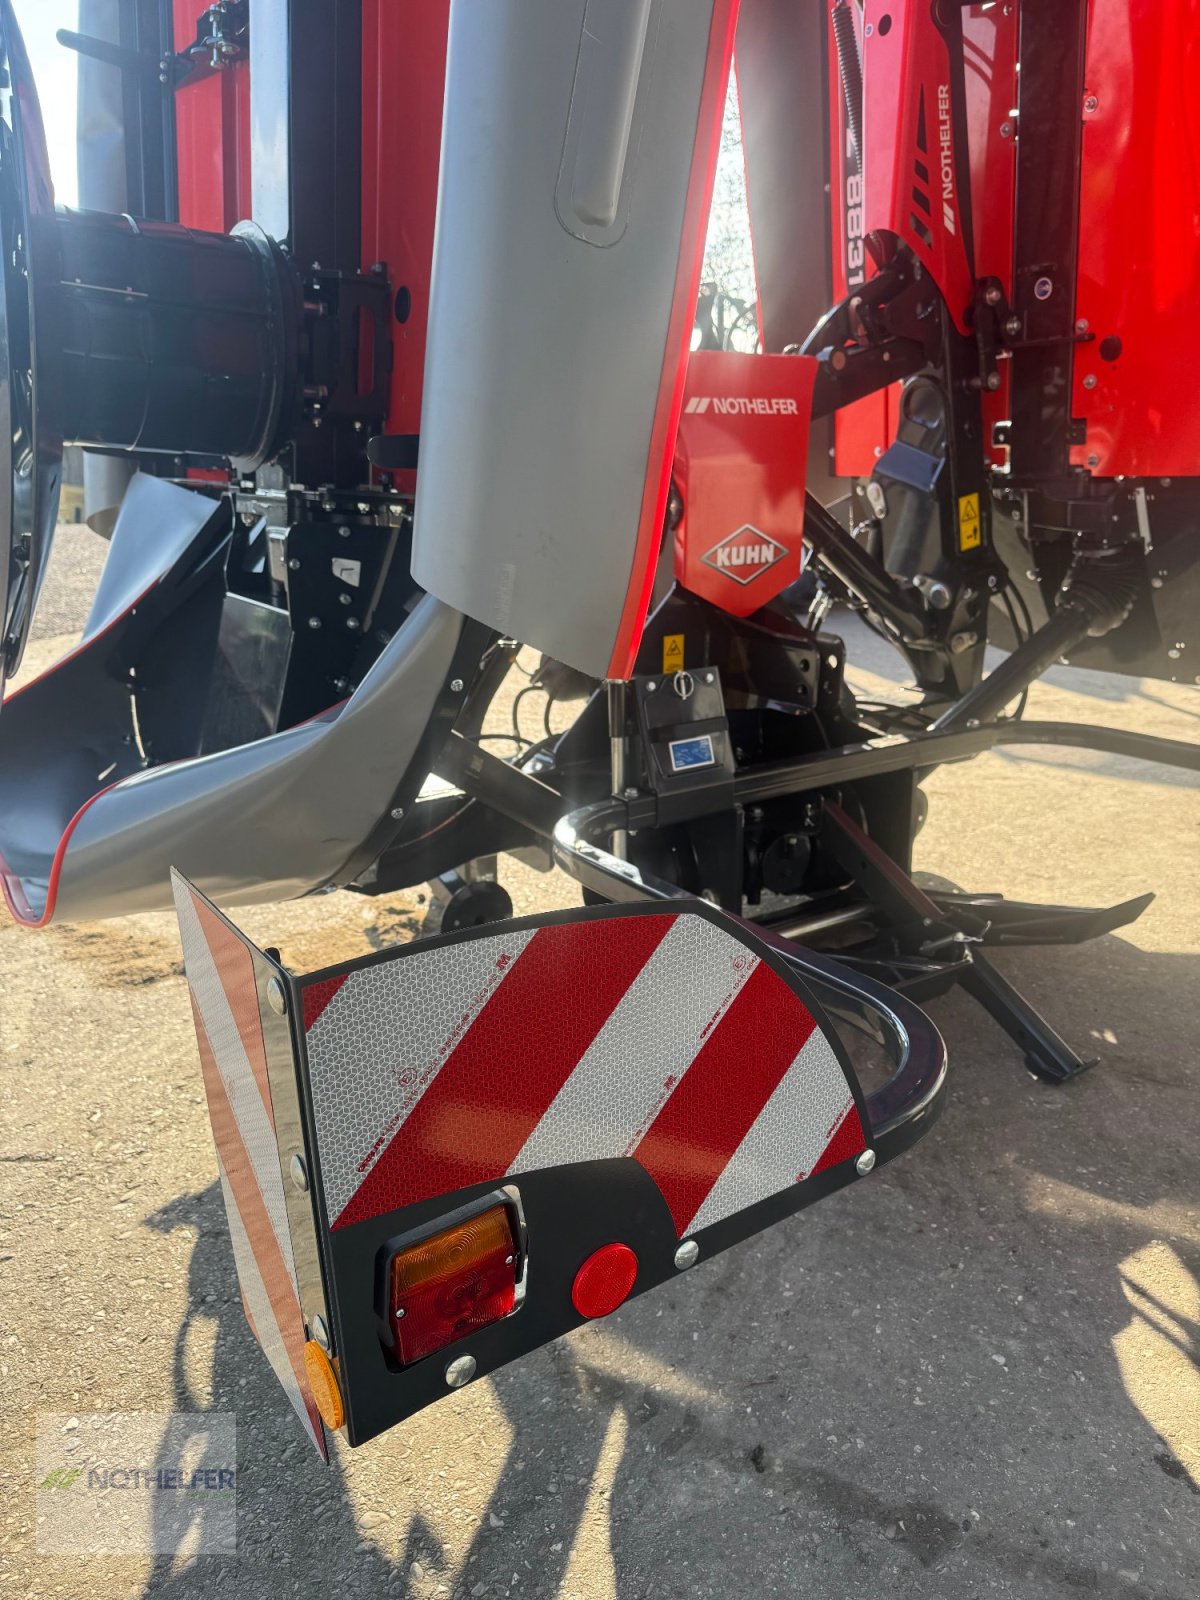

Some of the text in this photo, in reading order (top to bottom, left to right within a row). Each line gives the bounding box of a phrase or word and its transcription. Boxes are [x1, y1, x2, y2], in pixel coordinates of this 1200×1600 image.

[938, 84, 953, 198] NOTHELFER
[846, 174, 865, 286] 8831
[712, 397, 798, 415] NOTHELFER
[716, 544, 775, 568] KUHN
